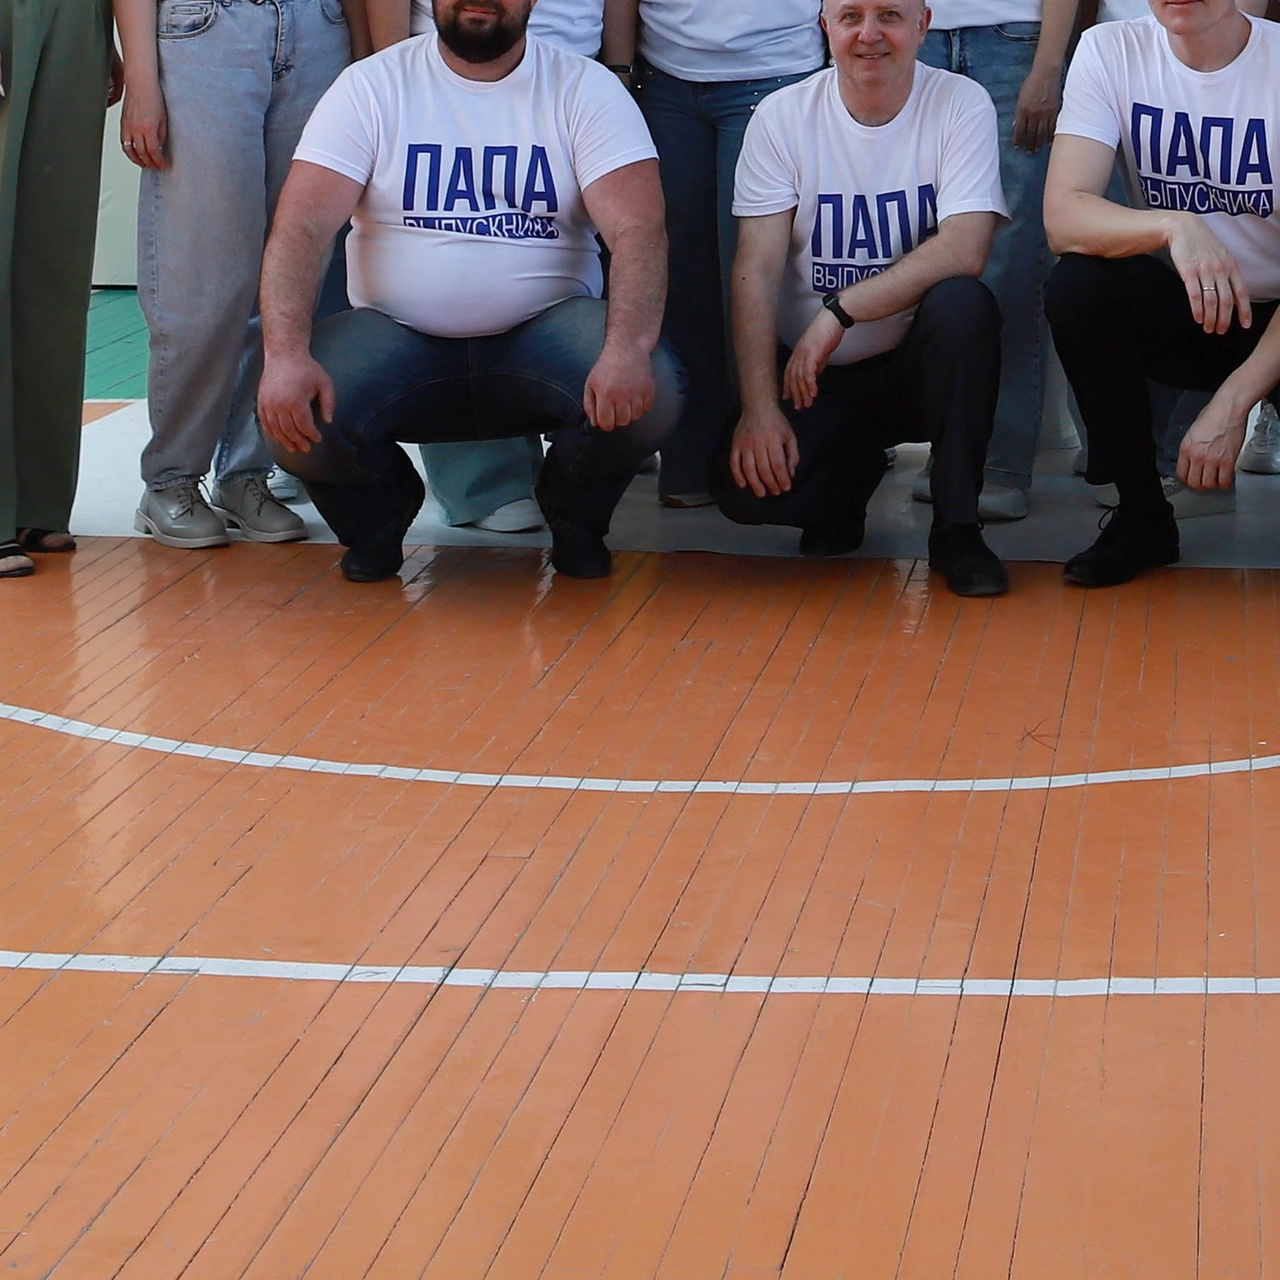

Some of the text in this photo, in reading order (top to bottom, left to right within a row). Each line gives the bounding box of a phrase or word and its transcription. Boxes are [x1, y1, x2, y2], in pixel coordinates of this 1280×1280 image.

[402, 143, 559, 213] ПАПА
[1130, 101, 1274, 186] ПАПА
[811, 183, 939, 260] ПАПА
